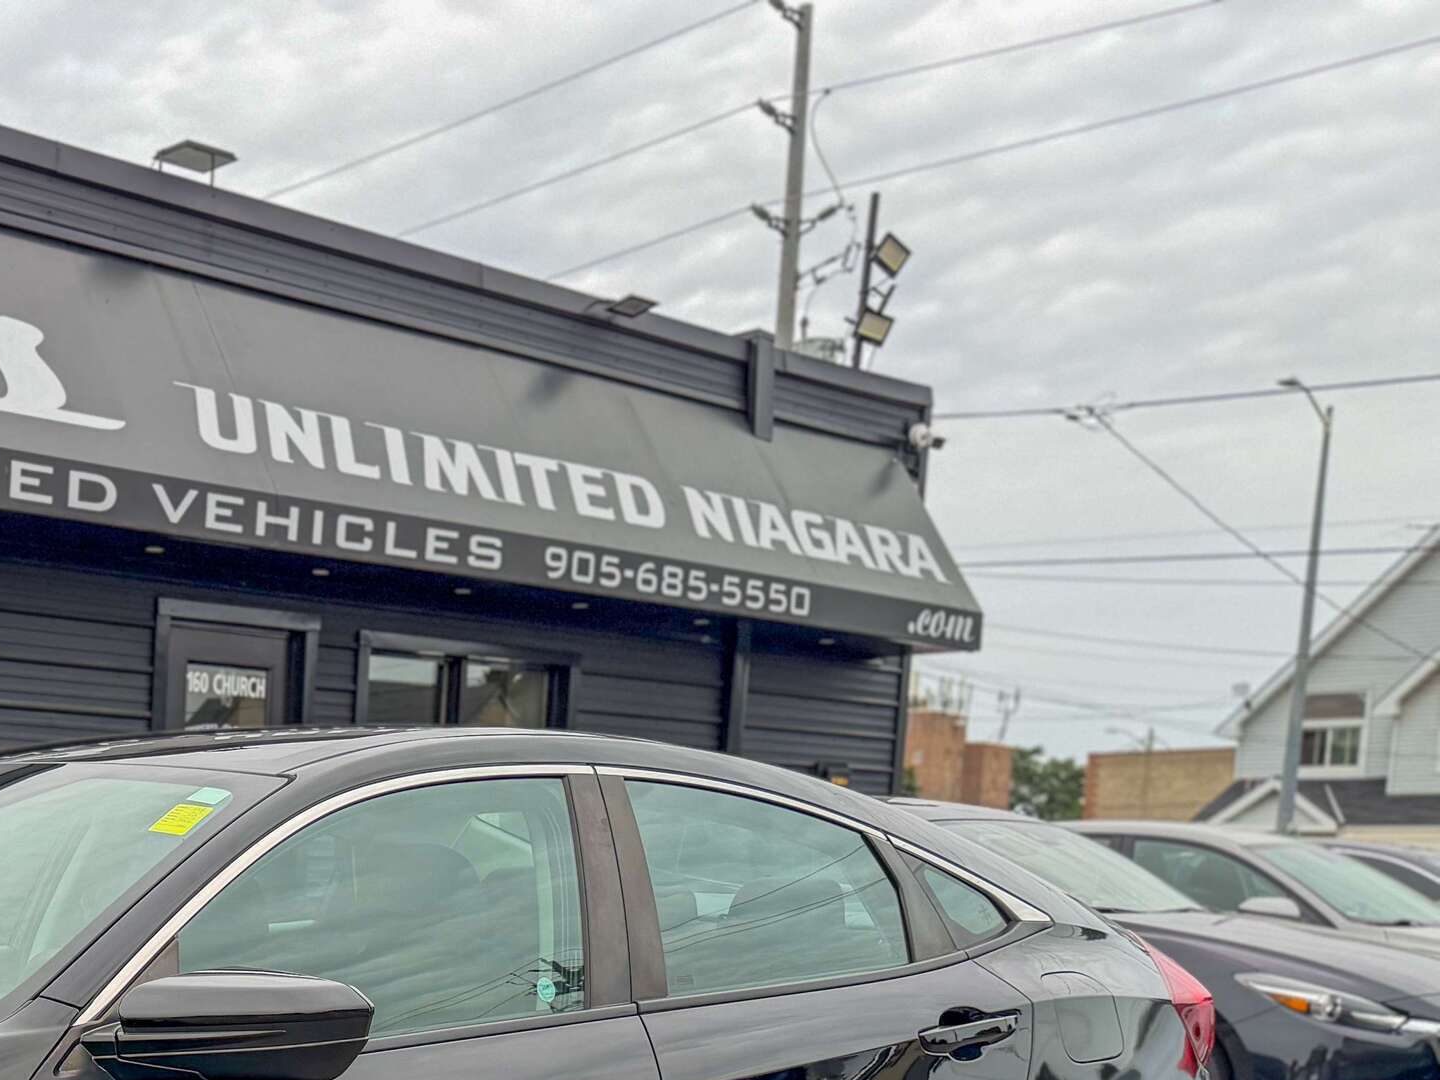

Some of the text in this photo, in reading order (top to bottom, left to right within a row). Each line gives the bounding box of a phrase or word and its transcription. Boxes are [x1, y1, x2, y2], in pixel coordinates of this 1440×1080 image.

[173, 381, 945, 583] UNLIMITED NIAGARA
[152, 483, 503, 572] VEHICLES
[544, 546, 811, 617] 905-685-5550
[907, 608, 976, 643] .com
[186, 671, 266, 699] 160 CHURCH
